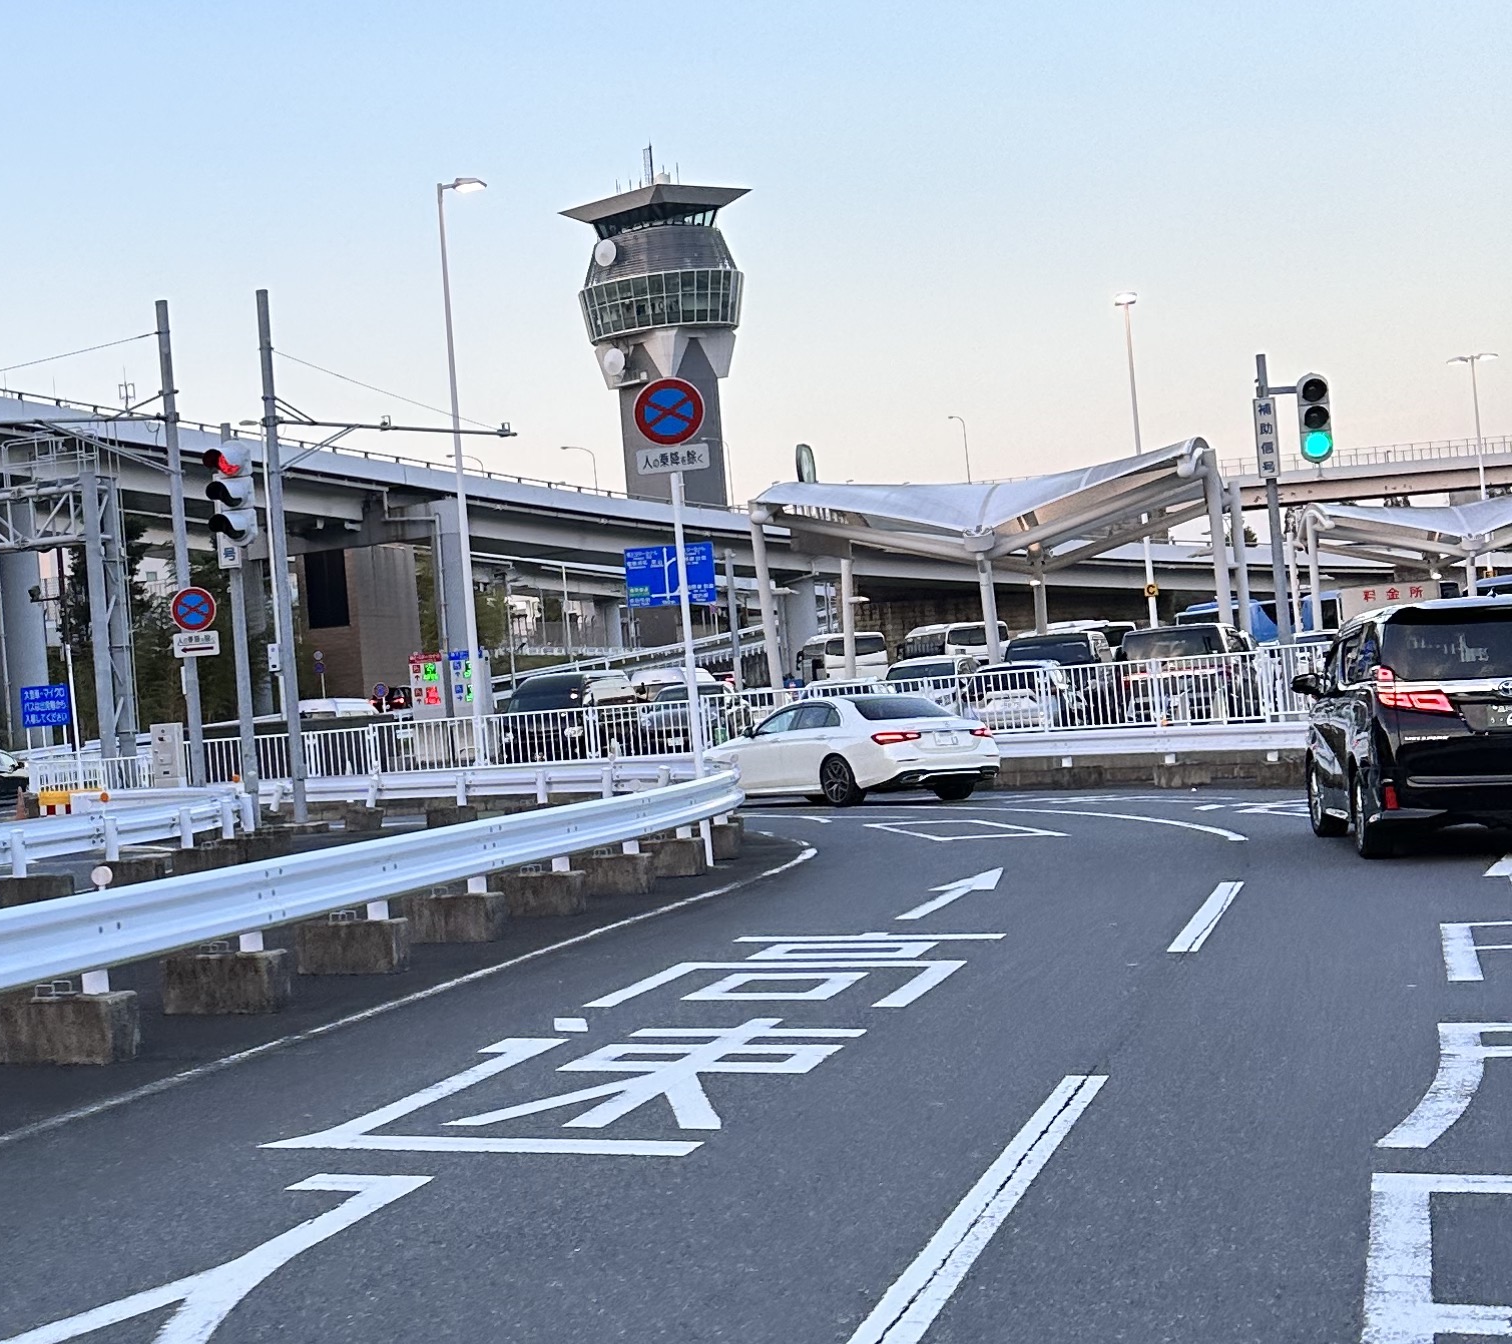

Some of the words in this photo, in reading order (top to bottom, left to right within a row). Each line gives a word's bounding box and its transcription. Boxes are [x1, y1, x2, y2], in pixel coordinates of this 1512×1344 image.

[1257, 402, 1276, 474] 補助信号
[642, 450, 704, 470] 人の乗降を除く
[1146, 584, 1156, 596] C
